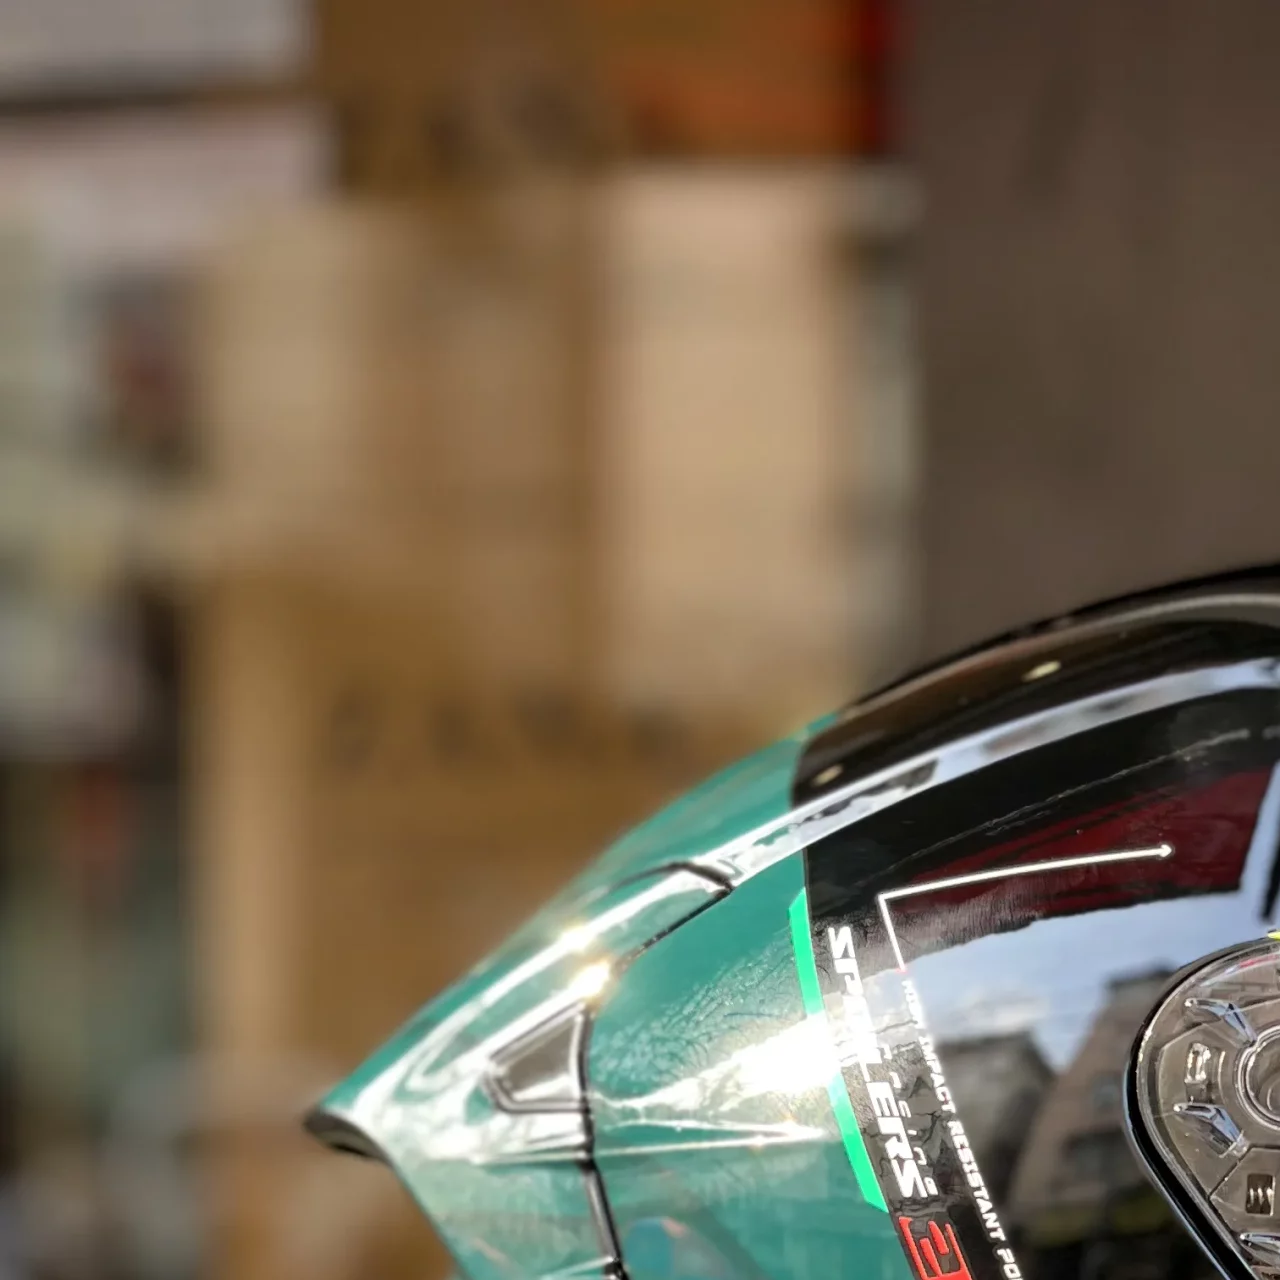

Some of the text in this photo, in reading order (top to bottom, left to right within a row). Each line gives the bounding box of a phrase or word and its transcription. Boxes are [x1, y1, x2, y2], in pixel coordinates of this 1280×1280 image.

[828, 926, 928, 1199] SPOLERS
[918, 1036, 957, 1115] IMPACT
[947, 1120, 1006, 1242] RESISTANT
